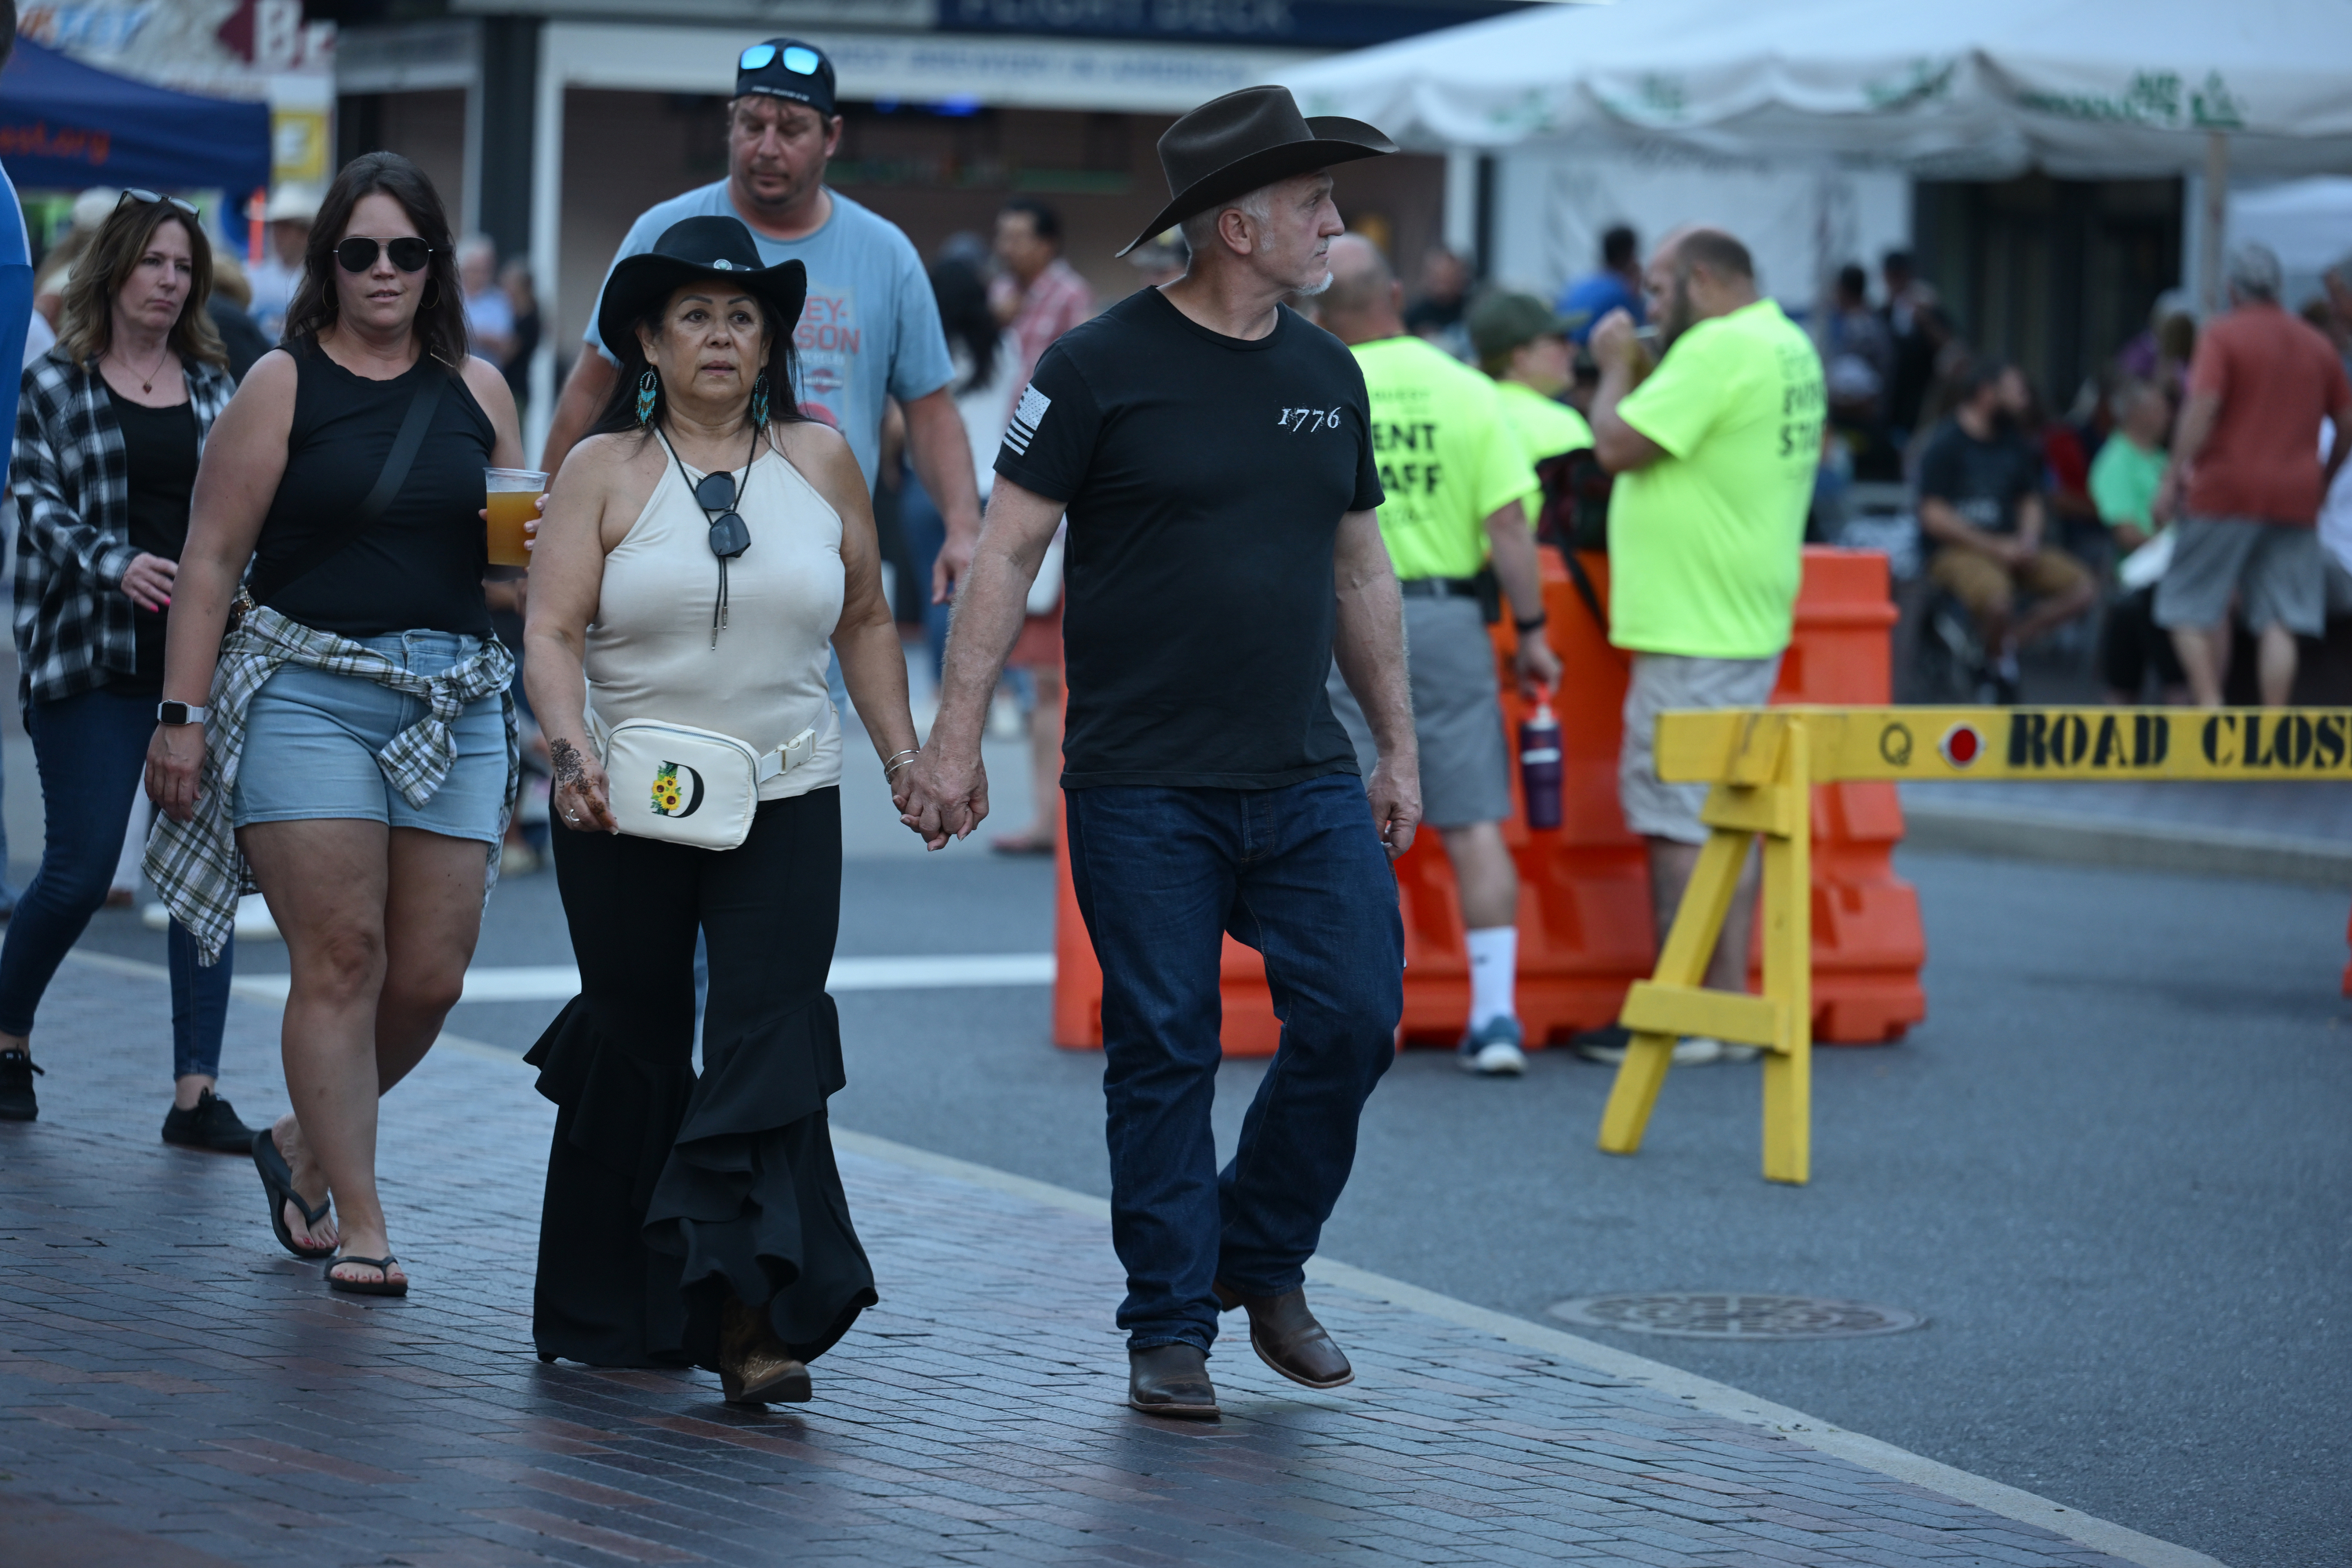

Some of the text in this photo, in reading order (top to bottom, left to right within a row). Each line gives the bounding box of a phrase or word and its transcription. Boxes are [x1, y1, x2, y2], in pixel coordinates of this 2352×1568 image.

[800, 296, 848, 322] EY-
[1277, 406, 1341, 433] 1776
[2008, 713, 2169, 769] ROAD
[2201, 713, 2352, 769] CLOS
[651, 760, 705, 818] D
